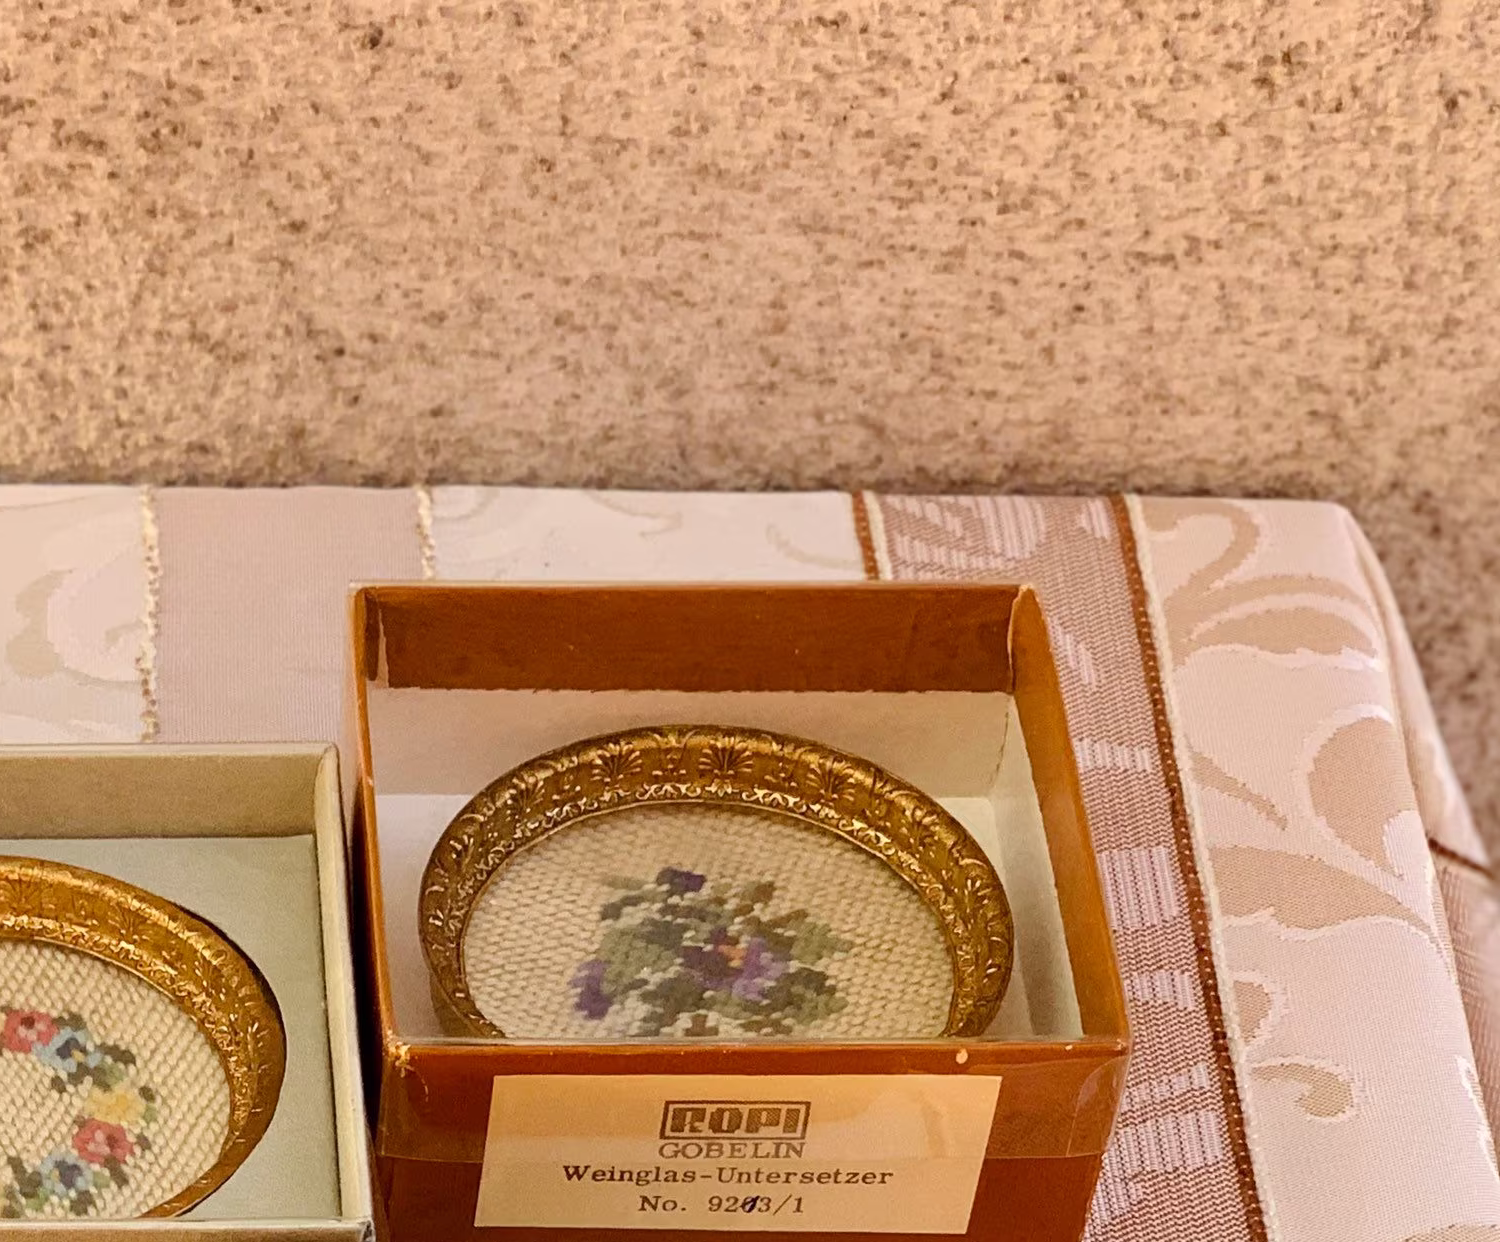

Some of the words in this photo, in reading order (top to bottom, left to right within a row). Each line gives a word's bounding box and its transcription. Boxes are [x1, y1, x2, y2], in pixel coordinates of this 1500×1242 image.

[670, 1106, 800, 1133] ROPI
[658, 1142, 806, 1158] GOBELIN
[563, 1165, 893, 1186] Weinglas-Untersetzer
[638, 1195, 686, 1212] No.
